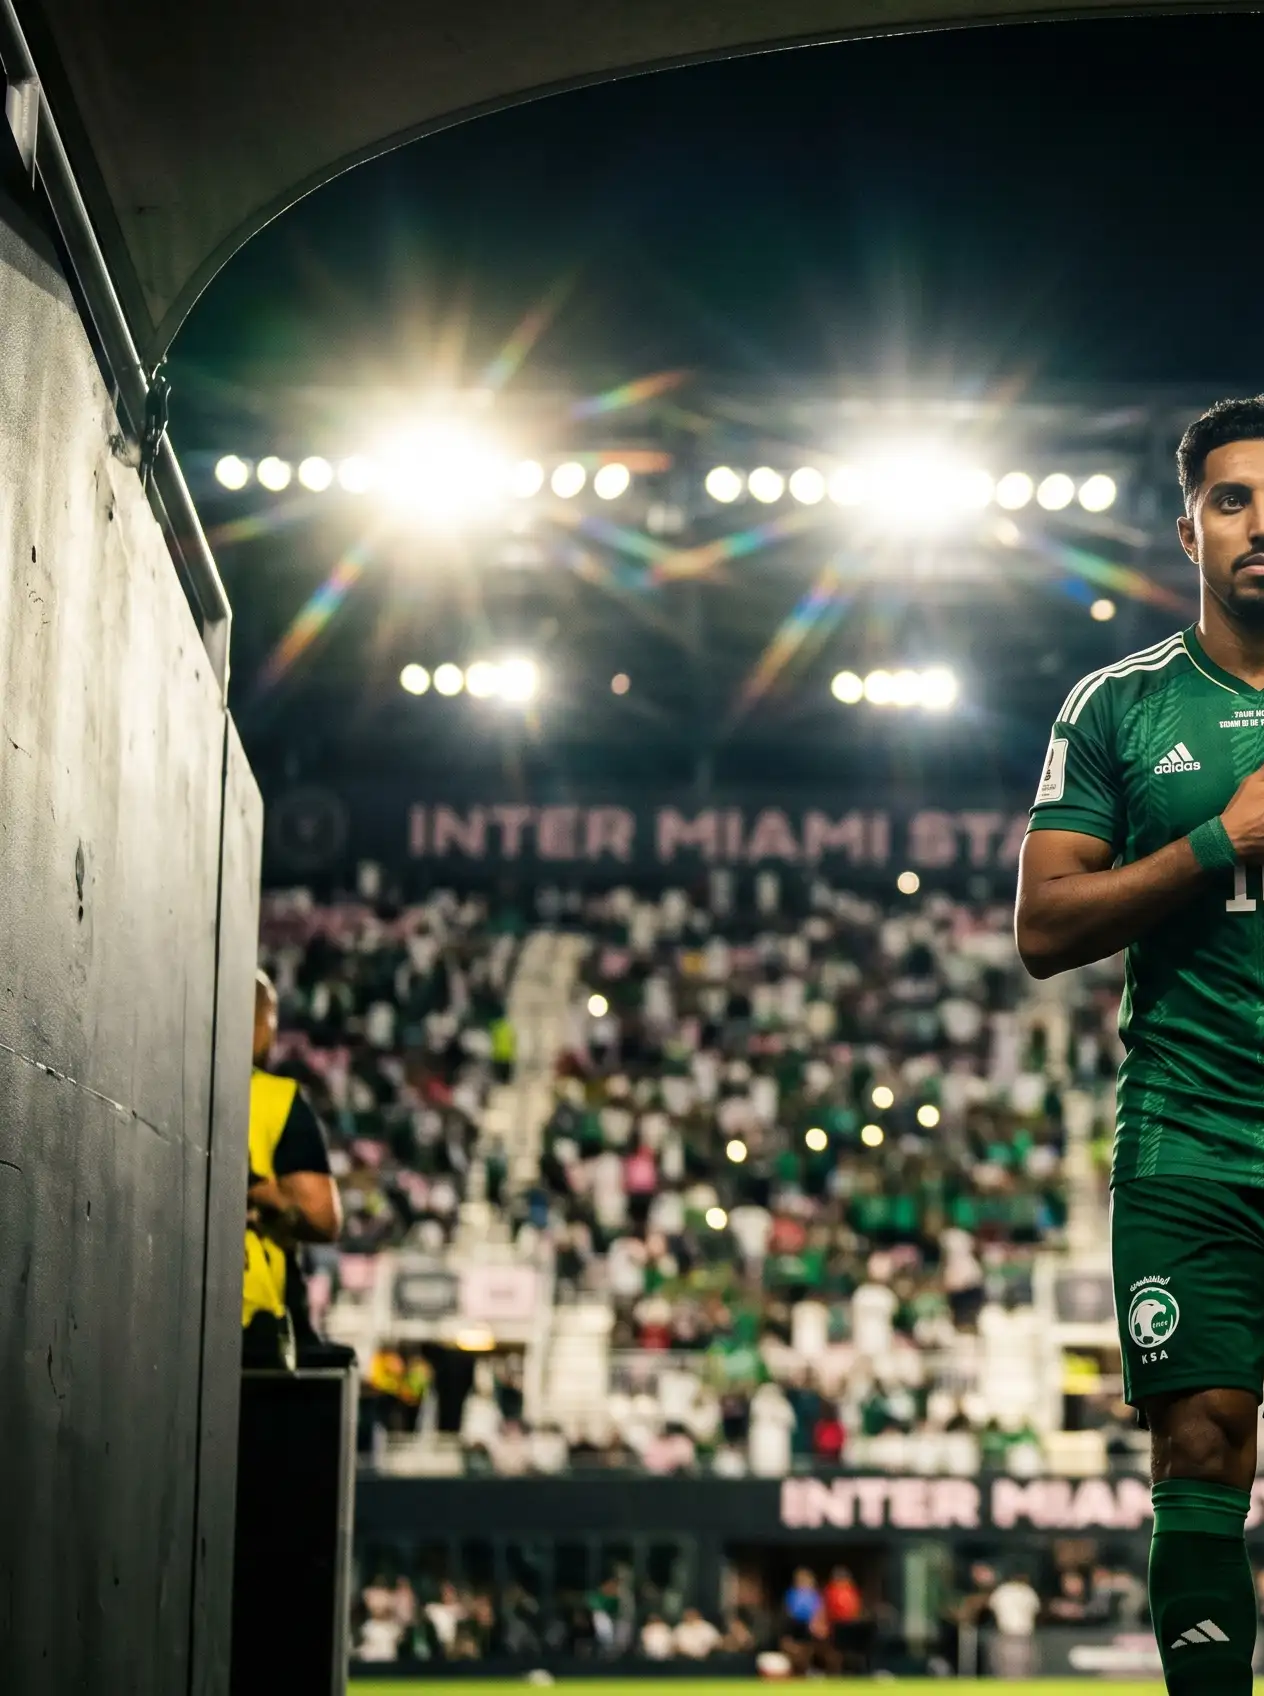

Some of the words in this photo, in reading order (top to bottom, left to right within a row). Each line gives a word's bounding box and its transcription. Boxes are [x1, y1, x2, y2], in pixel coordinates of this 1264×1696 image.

[1154, 761, 1201, 775] adidas
[408, 803, 635, 862] INTER
[655, 805, 891, 871] MIAMI
[1141, 1349, 1169, 1365] KSA
[780, 1477, 980, 1530] INTER
[991, 1477, 1153, 1531] MIAM
